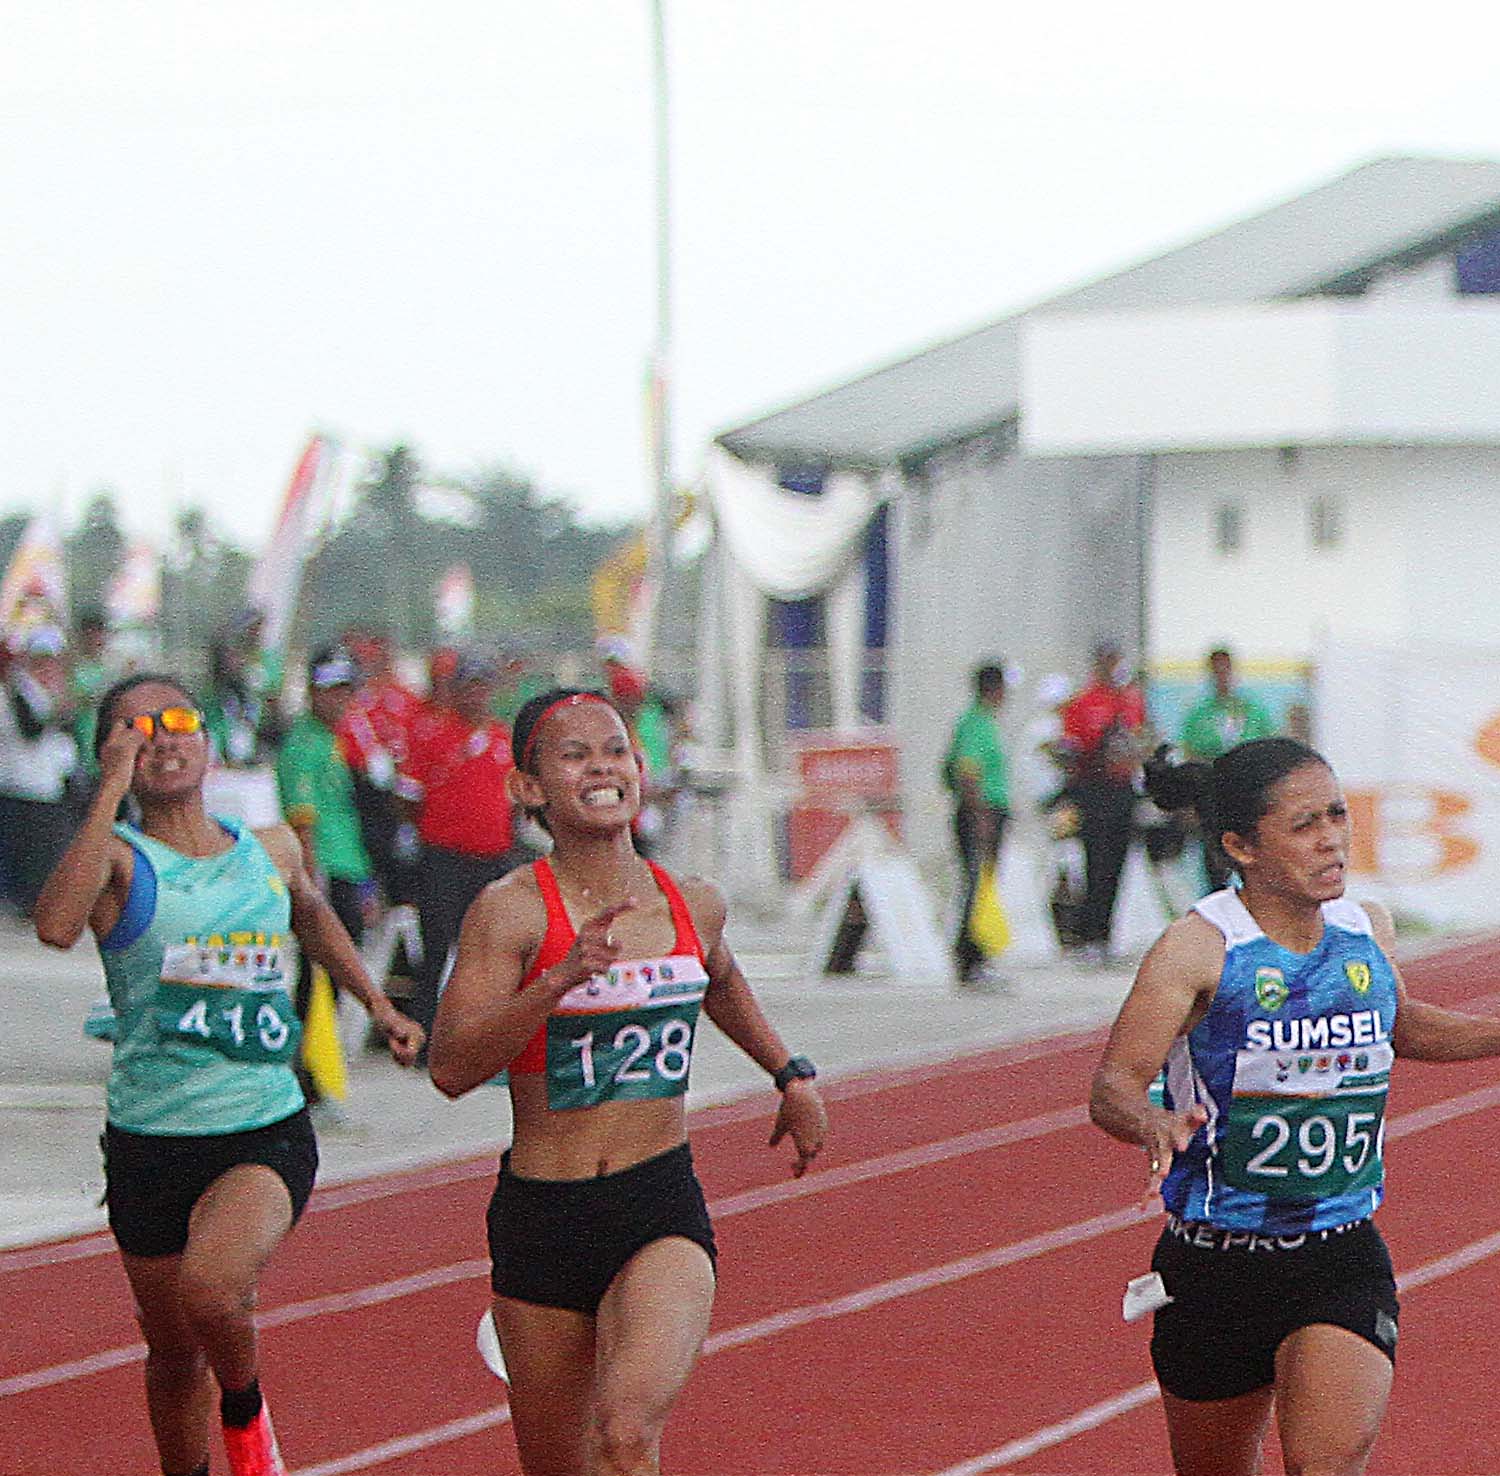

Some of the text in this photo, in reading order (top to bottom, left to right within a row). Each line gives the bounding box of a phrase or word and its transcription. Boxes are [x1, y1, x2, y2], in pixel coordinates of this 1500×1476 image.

[571, 1019, 692, 1088] 128
[1246, 1009, 1388, 1051] SUMSEL
[1245, 1112, 1377, 1178] 295
